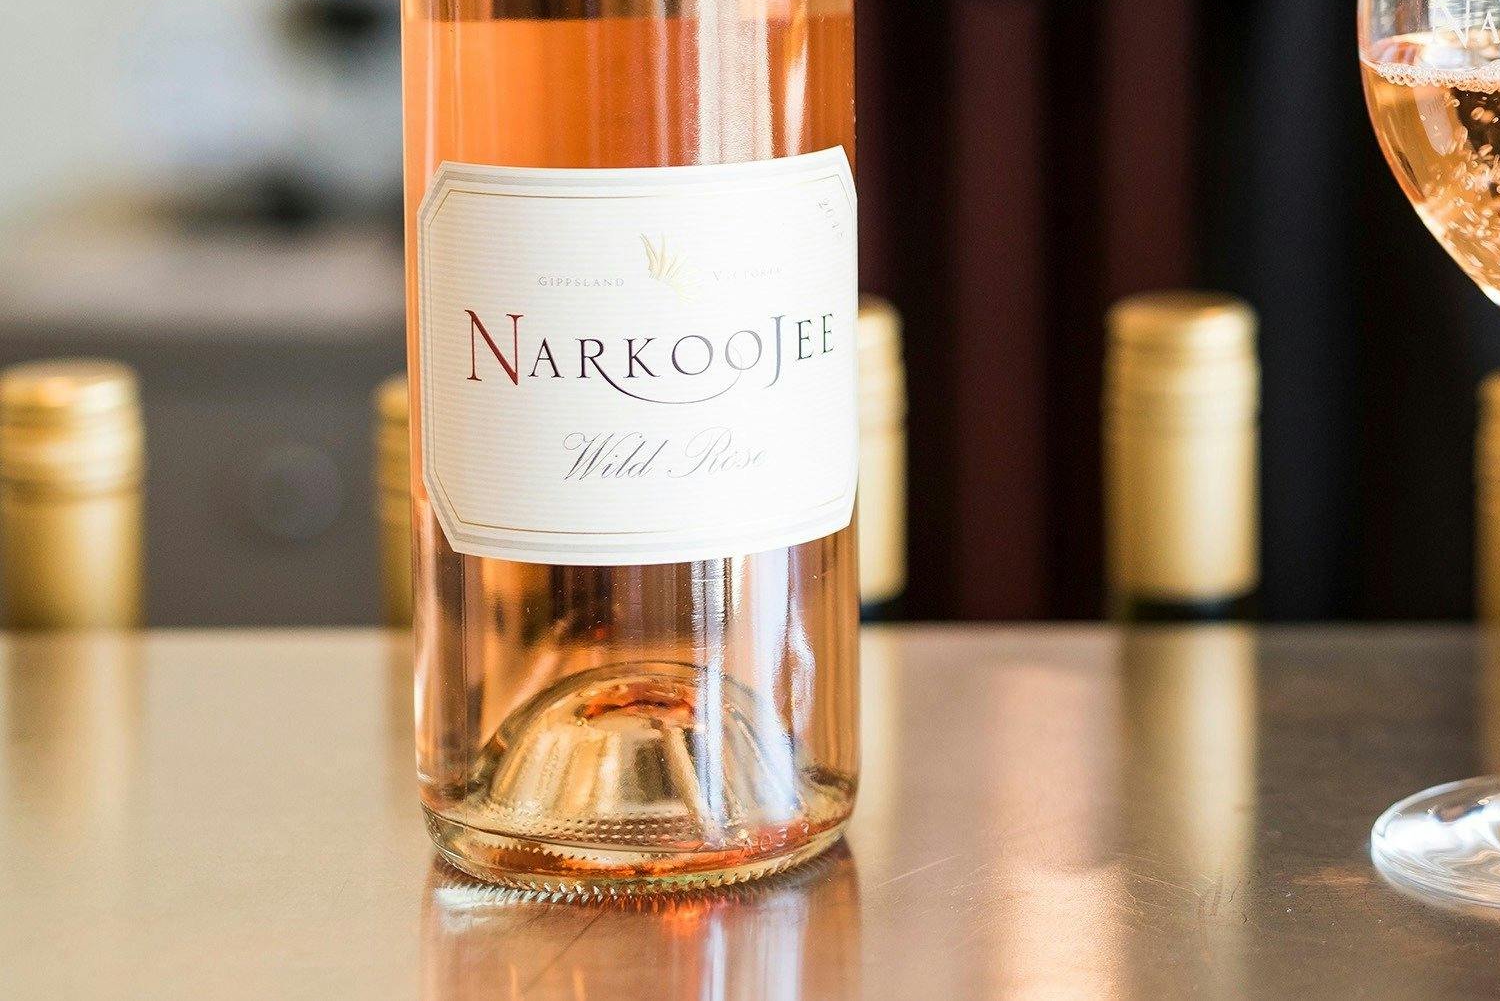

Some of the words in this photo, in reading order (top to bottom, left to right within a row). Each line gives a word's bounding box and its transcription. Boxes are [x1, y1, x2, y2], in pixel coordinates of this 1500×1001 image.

[536, 275, 626, 288] GIPPSLAND
[464, 309, 835, 405] NARKOOJEE
[563, 431, 669, 481] Wild
